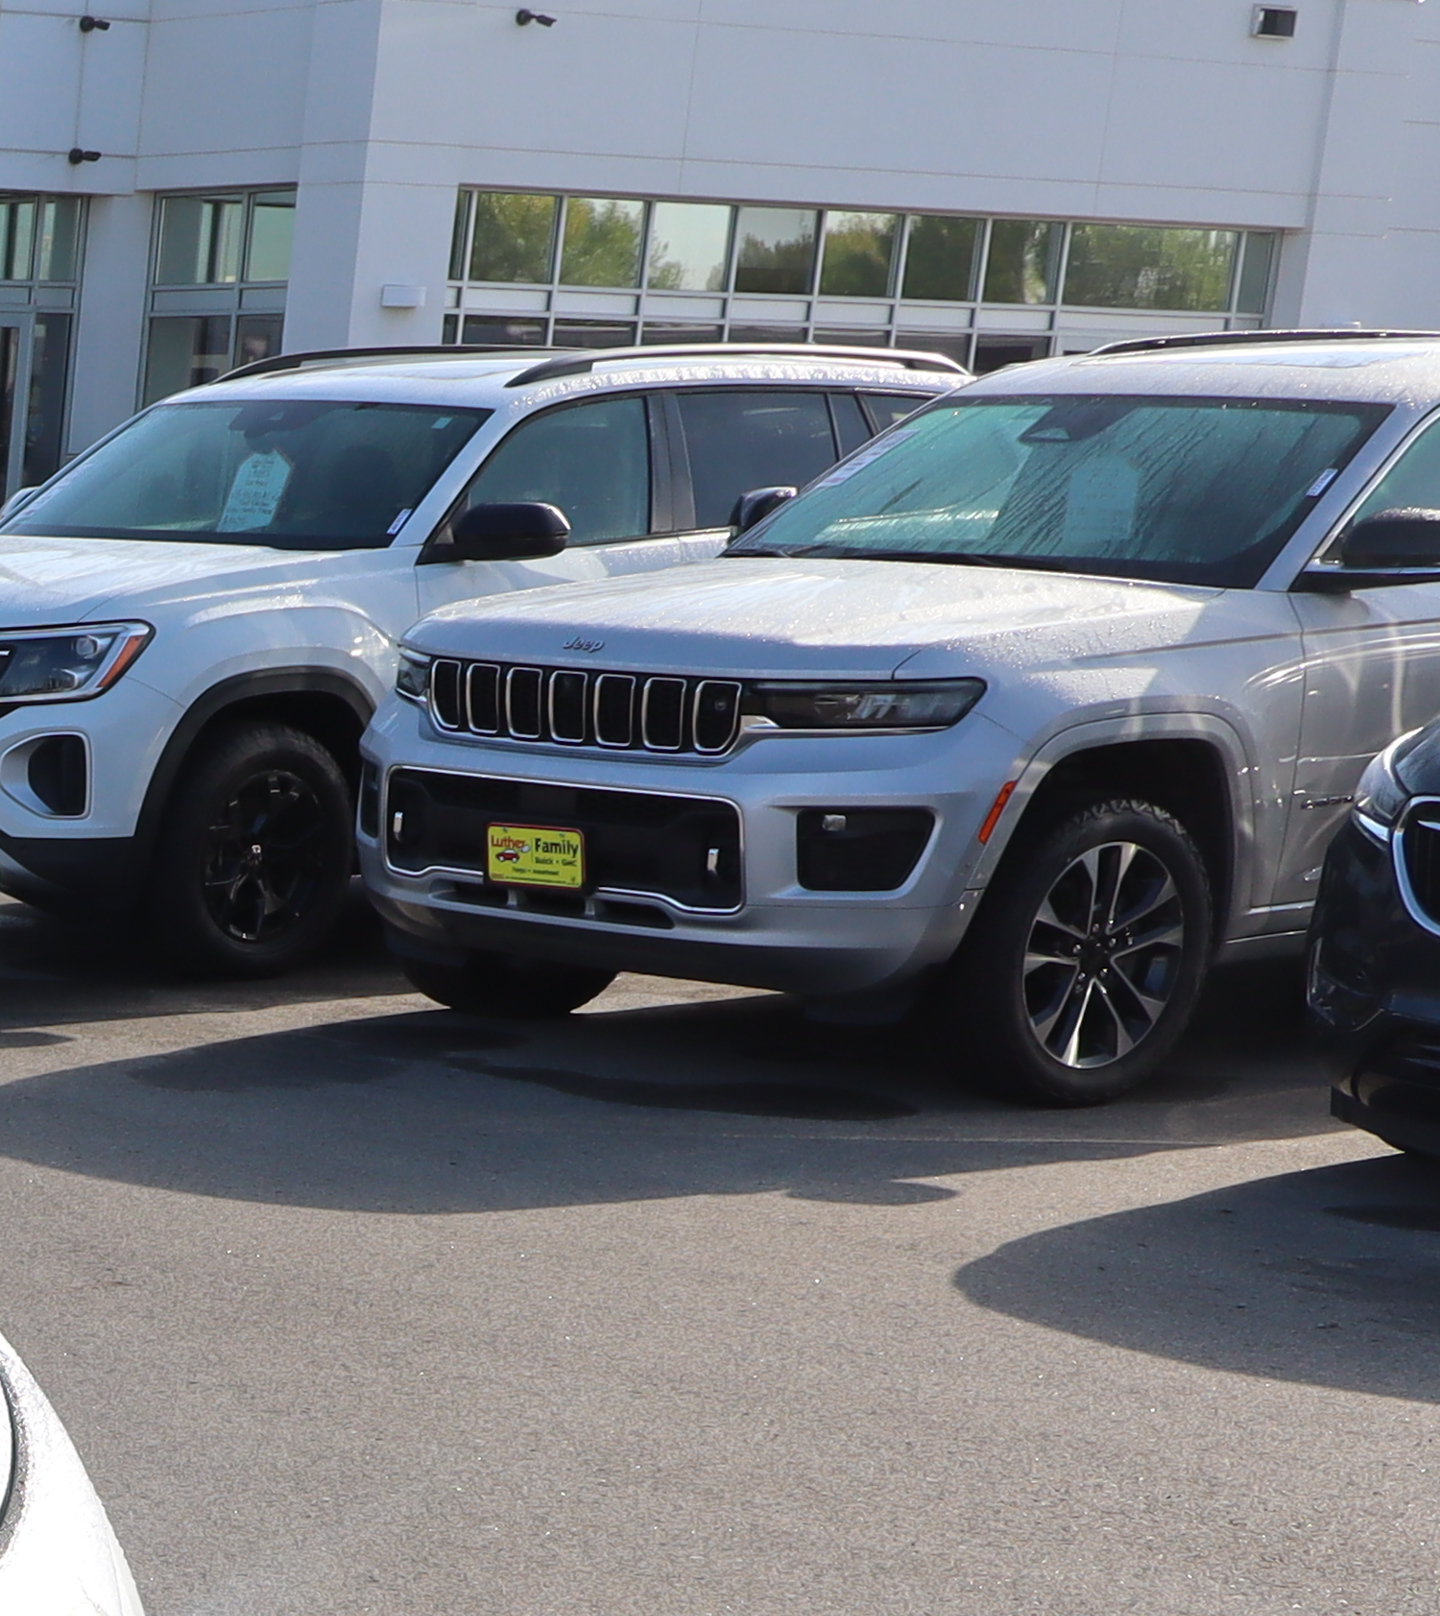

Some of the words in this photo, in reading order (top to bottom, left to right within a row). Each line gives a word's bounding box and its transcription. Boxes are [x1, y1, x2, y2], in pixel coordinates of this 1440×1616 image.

[563, 636, 605, 653] Jeep
[491, 835, 526, 849] Luther
[535, 838, 578, 858] Family
